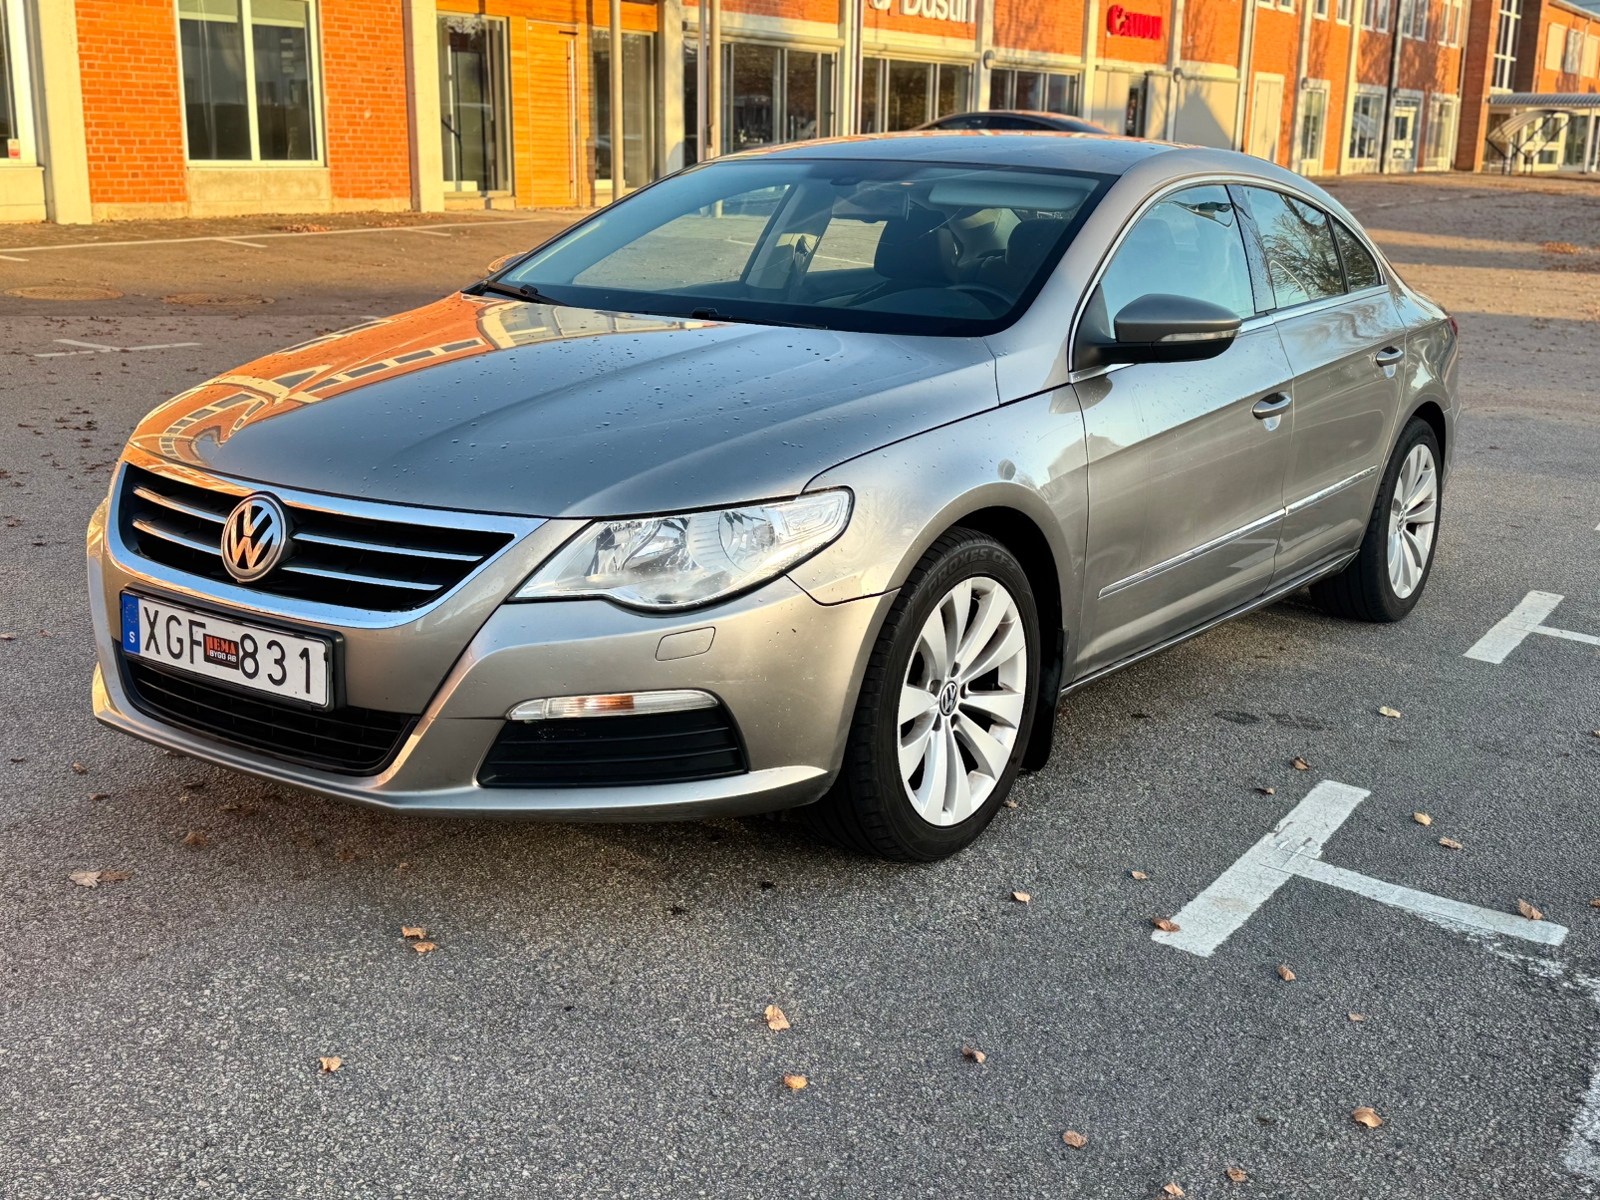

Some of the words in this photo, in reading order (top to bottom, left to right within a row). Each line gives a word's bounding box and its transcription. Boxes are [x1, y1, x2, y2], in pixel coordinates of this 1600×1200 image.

[1107, 4, 1162, 40] Canon
[927, 548, 989, 596] PROXES
[128, 630, 136, 643] S
[144, 606, 206, 664] XGF
[239, 633, 310, 694] 831
